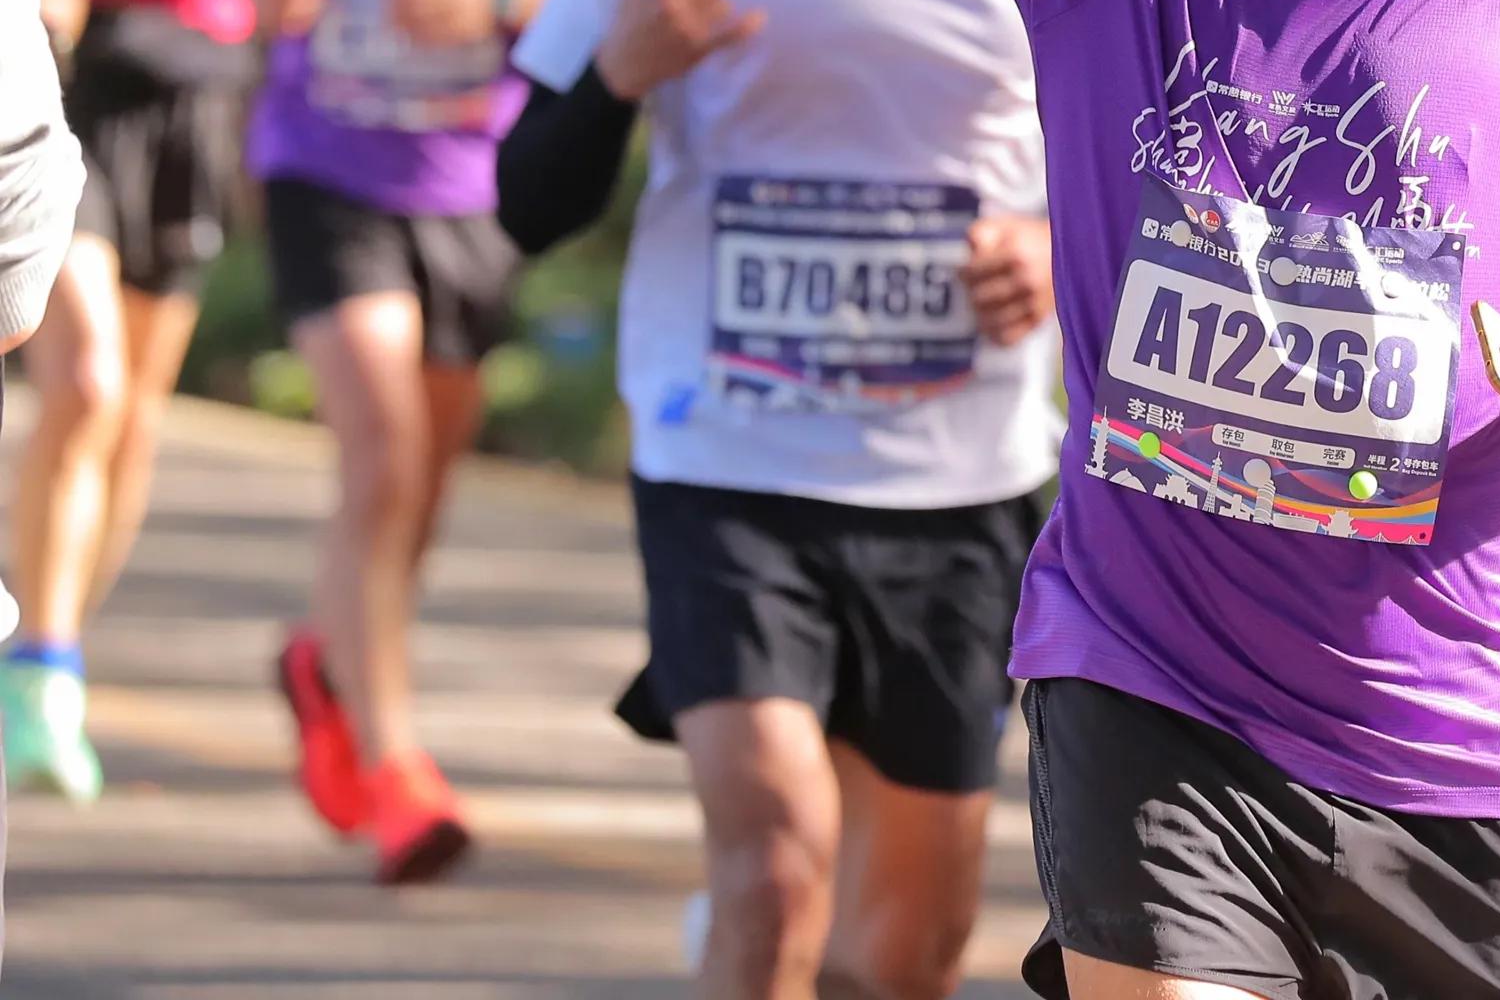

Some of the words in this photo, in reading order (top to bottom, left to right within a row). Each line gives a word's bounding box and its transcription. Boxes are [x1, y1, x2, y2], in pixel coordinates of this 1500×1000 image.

[737, 256, 952, 318] B70485
[1132, 287, 1419, 421] A12268
[1127, 397, 1185, 434] 李昌洪
[1222, 427, 1245, 442] 存包
[1271, 438, 1295, 454] 取包
[1322, 448, 1347, 461] 完赛
[1389, 457, 1401, 472] 2
